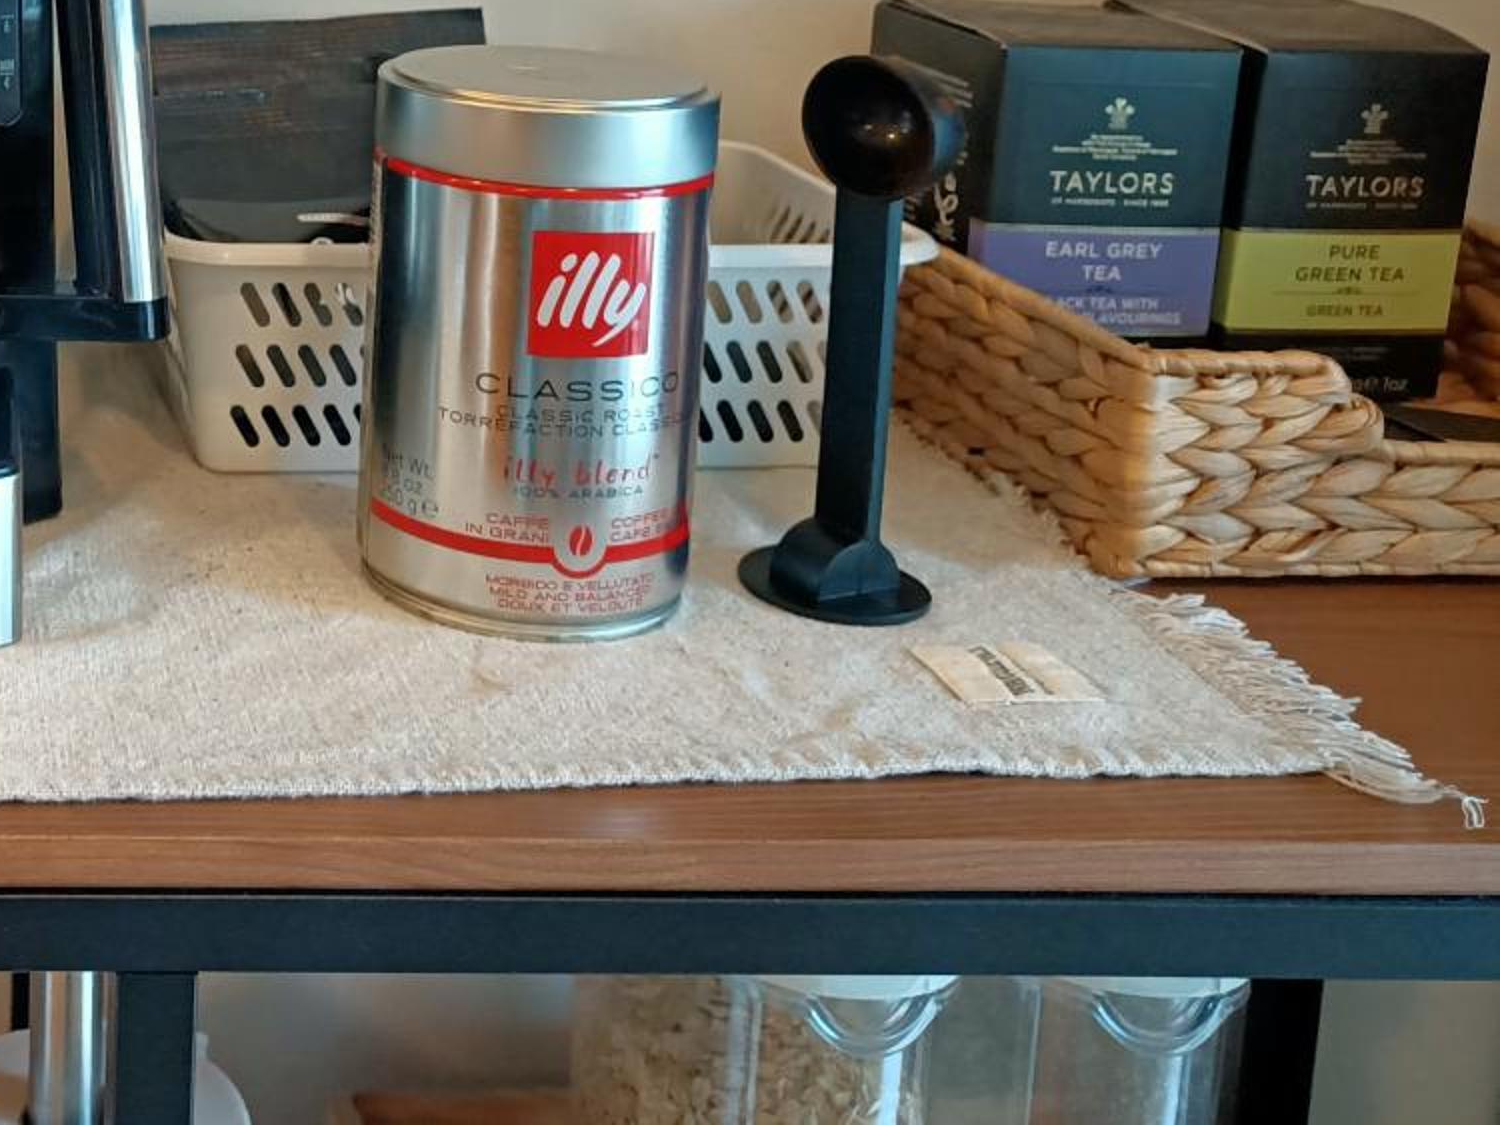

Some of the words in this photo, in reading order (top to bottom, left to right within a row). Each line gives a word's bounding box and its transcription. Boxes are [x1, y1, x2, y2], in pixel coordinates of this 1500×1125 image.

[1050, 170, 1175, 195] TAYLORS
[1305, 174, 1425, 197] TAYLORS
[1045, 240, 1099, 259] EARL
[1107, 242, 1163, 260] GREY
[1329, 244, 1381, 261] PURE
[1082, 264, 1122, 282] TEA
[1295, 266, 1363, 283] GREEN
[1370, 266, 1405, 283] TEA
[537, 251, 647, 347] illy
[1091, 296, 1117, 310] TEA
[1122, 297, 1159, 310] WITH
[1306, 304, 1353, 317] GREEN
[1358, 305, 1384, 317] TEA
[475, 371, 680, 403] CLASSICO
[497, 404, 594, 424] CLASSIC
[603, 402, 665, 423] ROAST
[503, 458, 557, 488] illy
[568, 484, 645, 499] ARABICA
[464, 522, 484, 535] IN
[489, 525, 550, 545] GRANI
[485, 574, 558, 592] MORBIDO
[563, 581, 574, 591] E
[489, 586, 528, 602] MILD
[534, 590, 571, 603] AND
[497, 598, 545, 611] DOUX
[551, 601, 572, 613] ET
